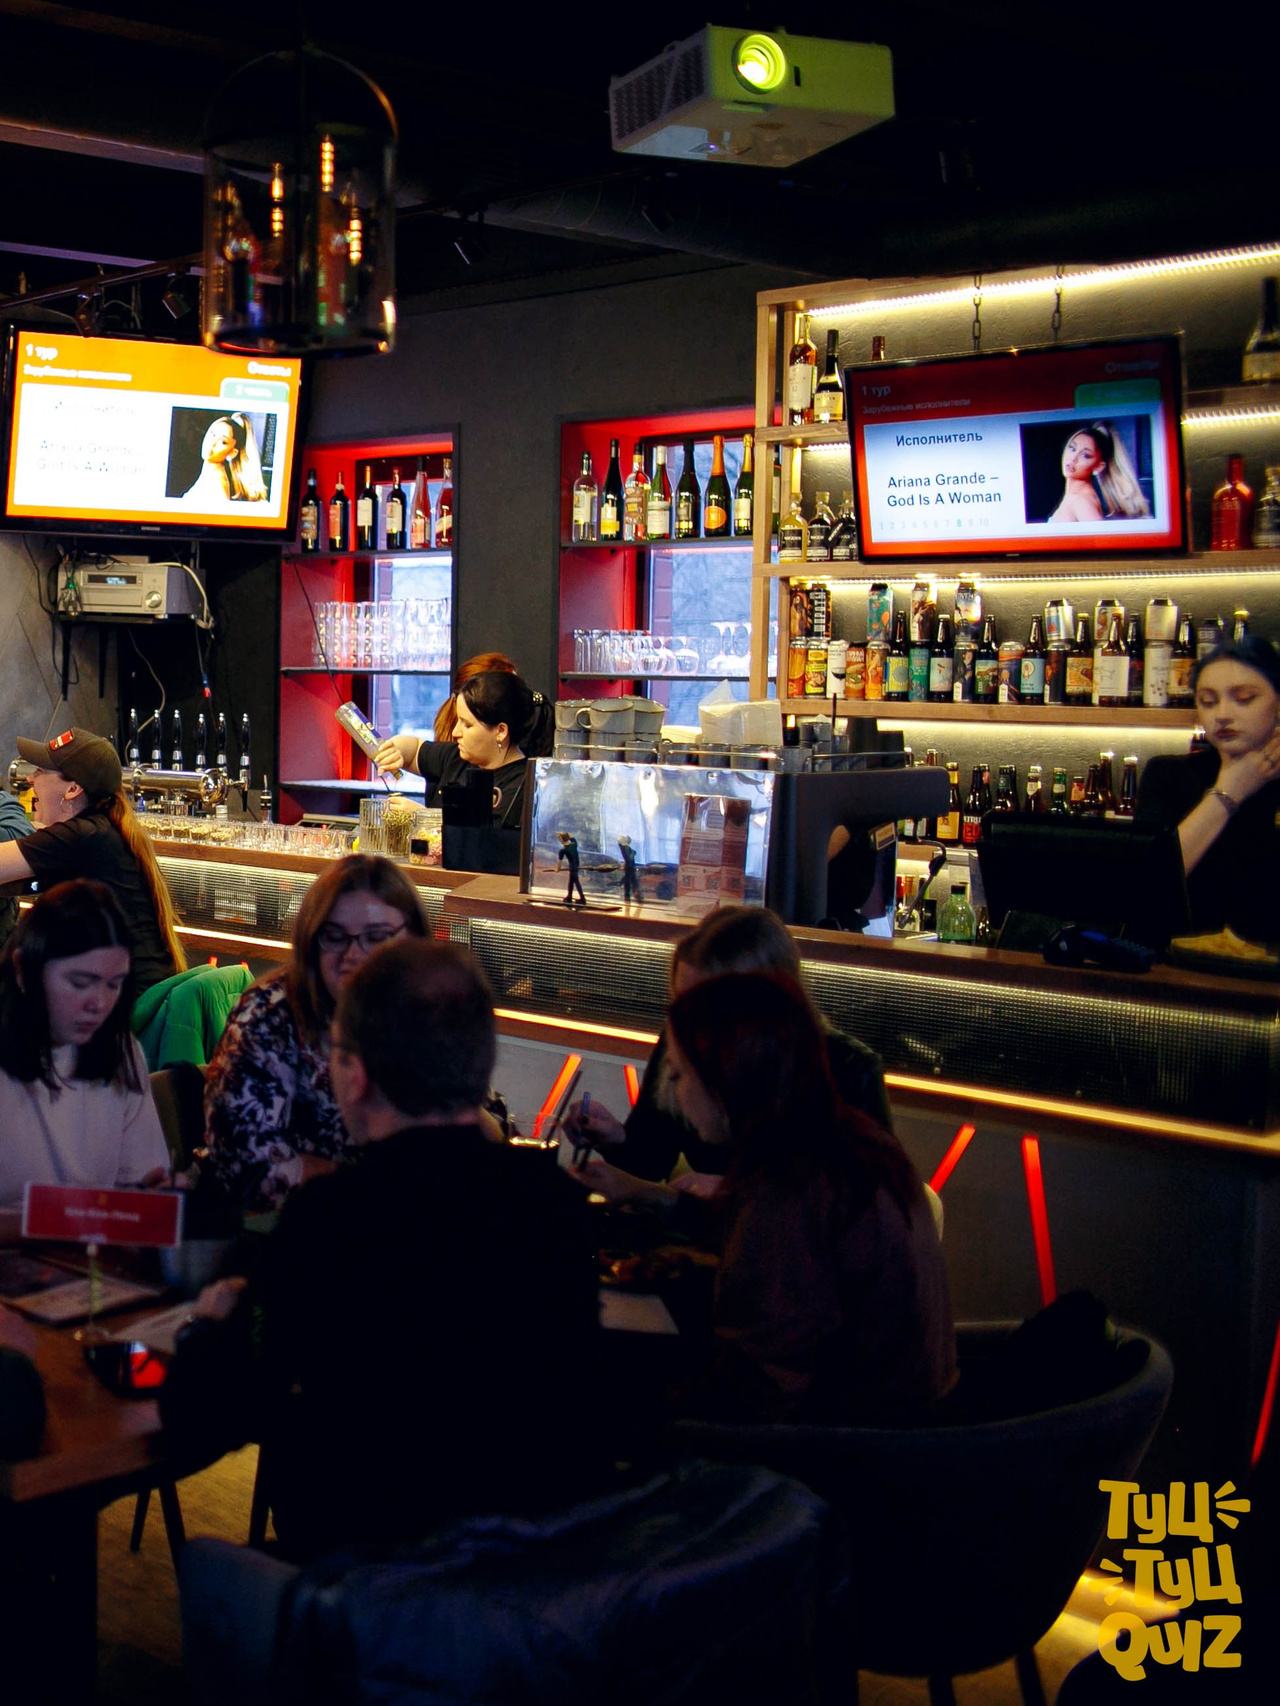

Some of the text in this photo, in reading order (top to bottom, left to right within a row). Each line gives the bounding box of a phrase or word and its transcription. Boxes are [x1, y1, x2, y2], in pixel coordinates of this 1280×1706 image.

[870, 385, 891, 398] тур
[895, 432, 983, 447] Исполнитель
[888, 476, 931, 489] Ariana
[935, 472, 986, 486] Grande
[887, 491, 1002, 507] God Is A Woman
